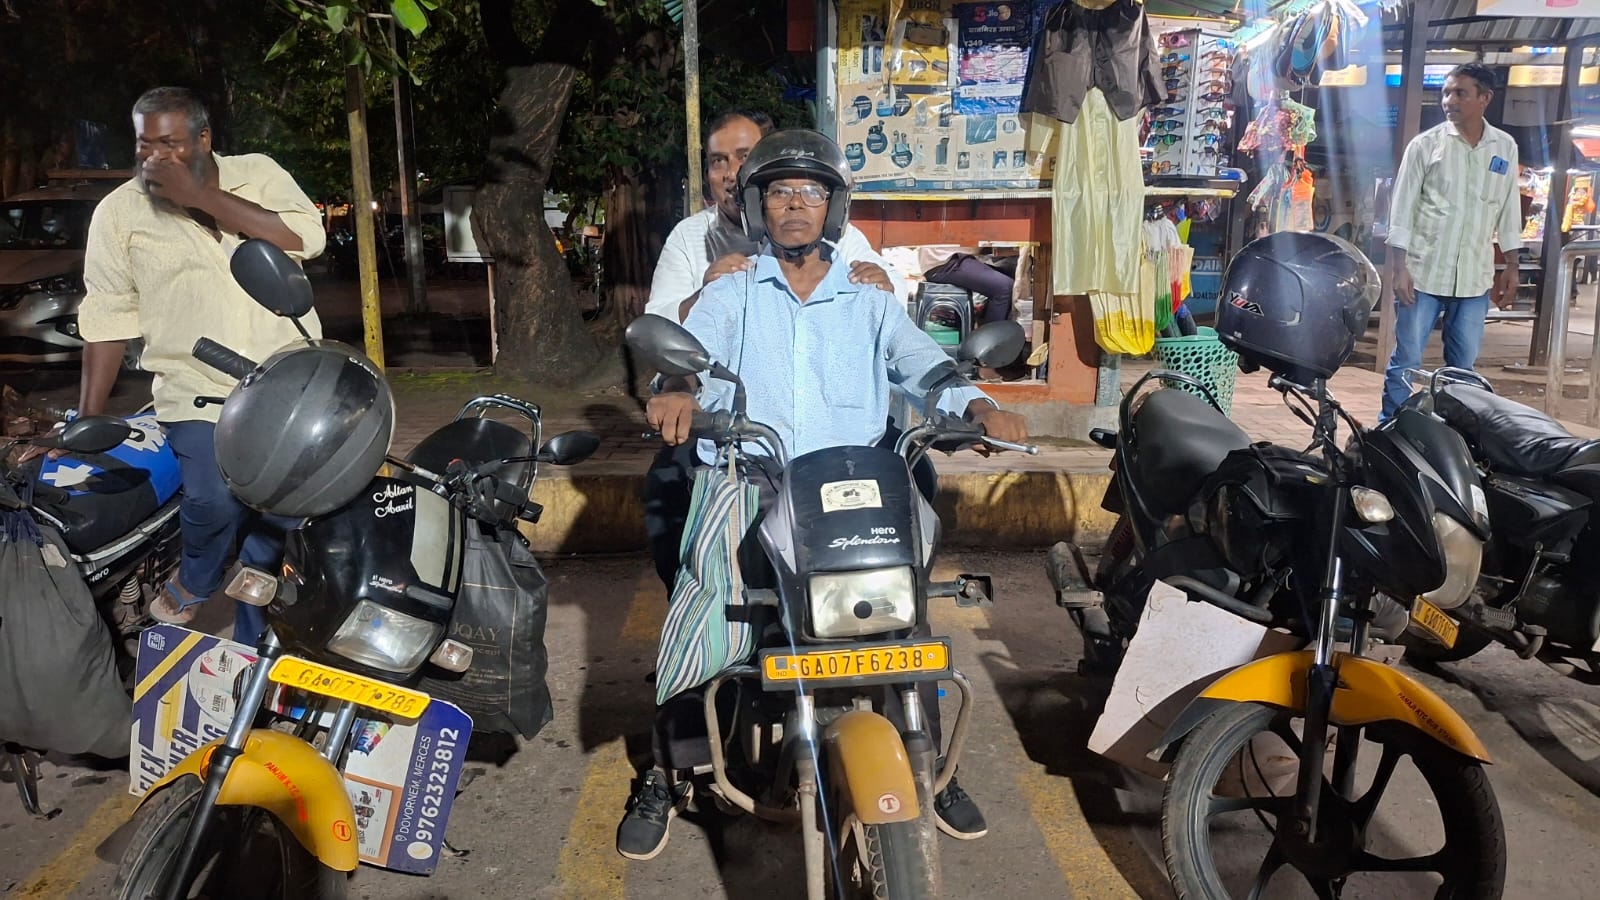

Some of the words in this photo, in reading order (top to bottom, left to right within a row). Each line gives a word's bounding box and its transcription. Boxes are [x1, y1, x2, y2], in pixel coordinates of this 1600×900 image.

[987, 9, 999, 17] Jio
[870, 526, 896, 535] Hero
[800, 649, 922, 676] GA07F6238
[413, 735, 432, 777] MERCES
[415, 727, 460, 841] 9762323812
[882, 797, 896, 810] T
